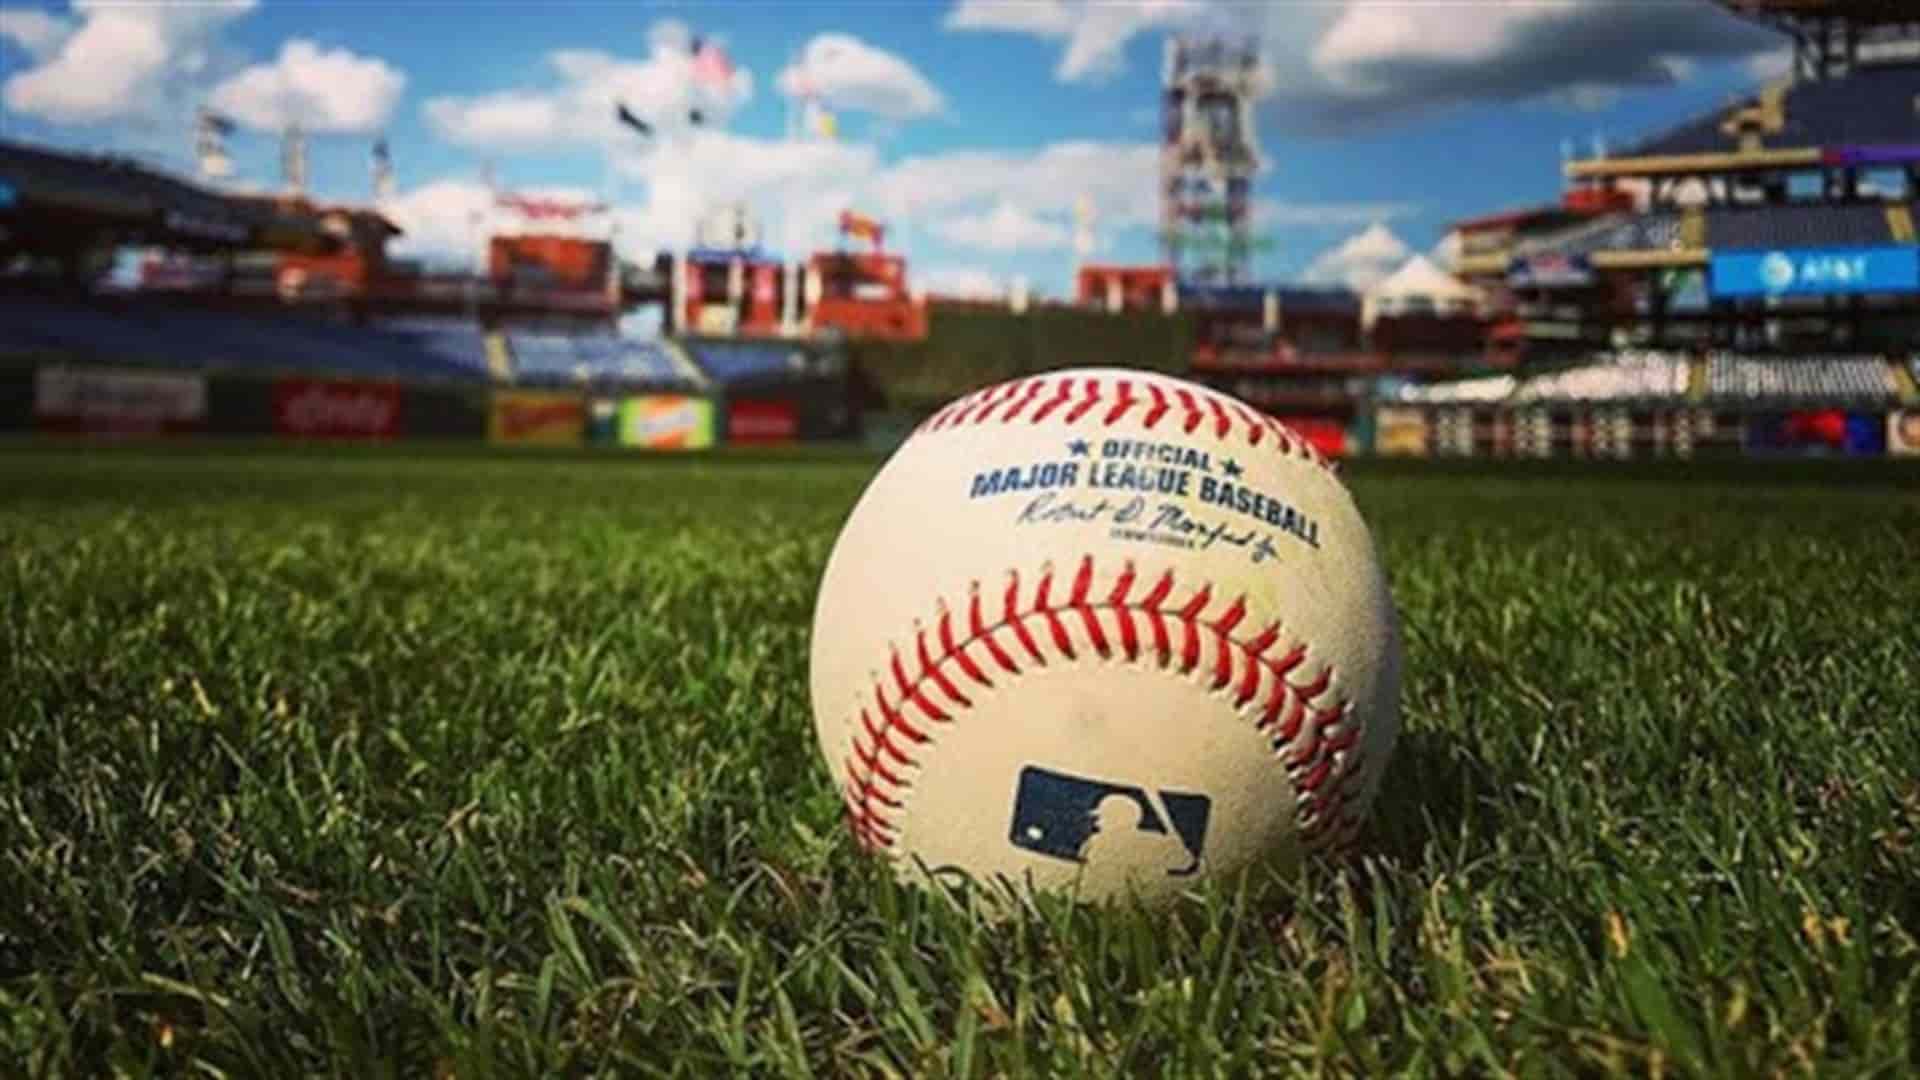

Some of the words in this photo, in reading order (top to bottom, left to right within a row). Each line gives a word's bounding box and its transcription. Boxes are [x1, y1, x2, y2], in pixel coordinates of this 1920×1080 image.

[1801, 255, 1867, 283] AT&T
[1101, 438, 1211, 472] OFFICIAL
[969, 462, 1078, 499] MAJOR
[1088, 461, 1189, 497] LEAGUE
[1199, 475, 1321, 550] BASEBALL
